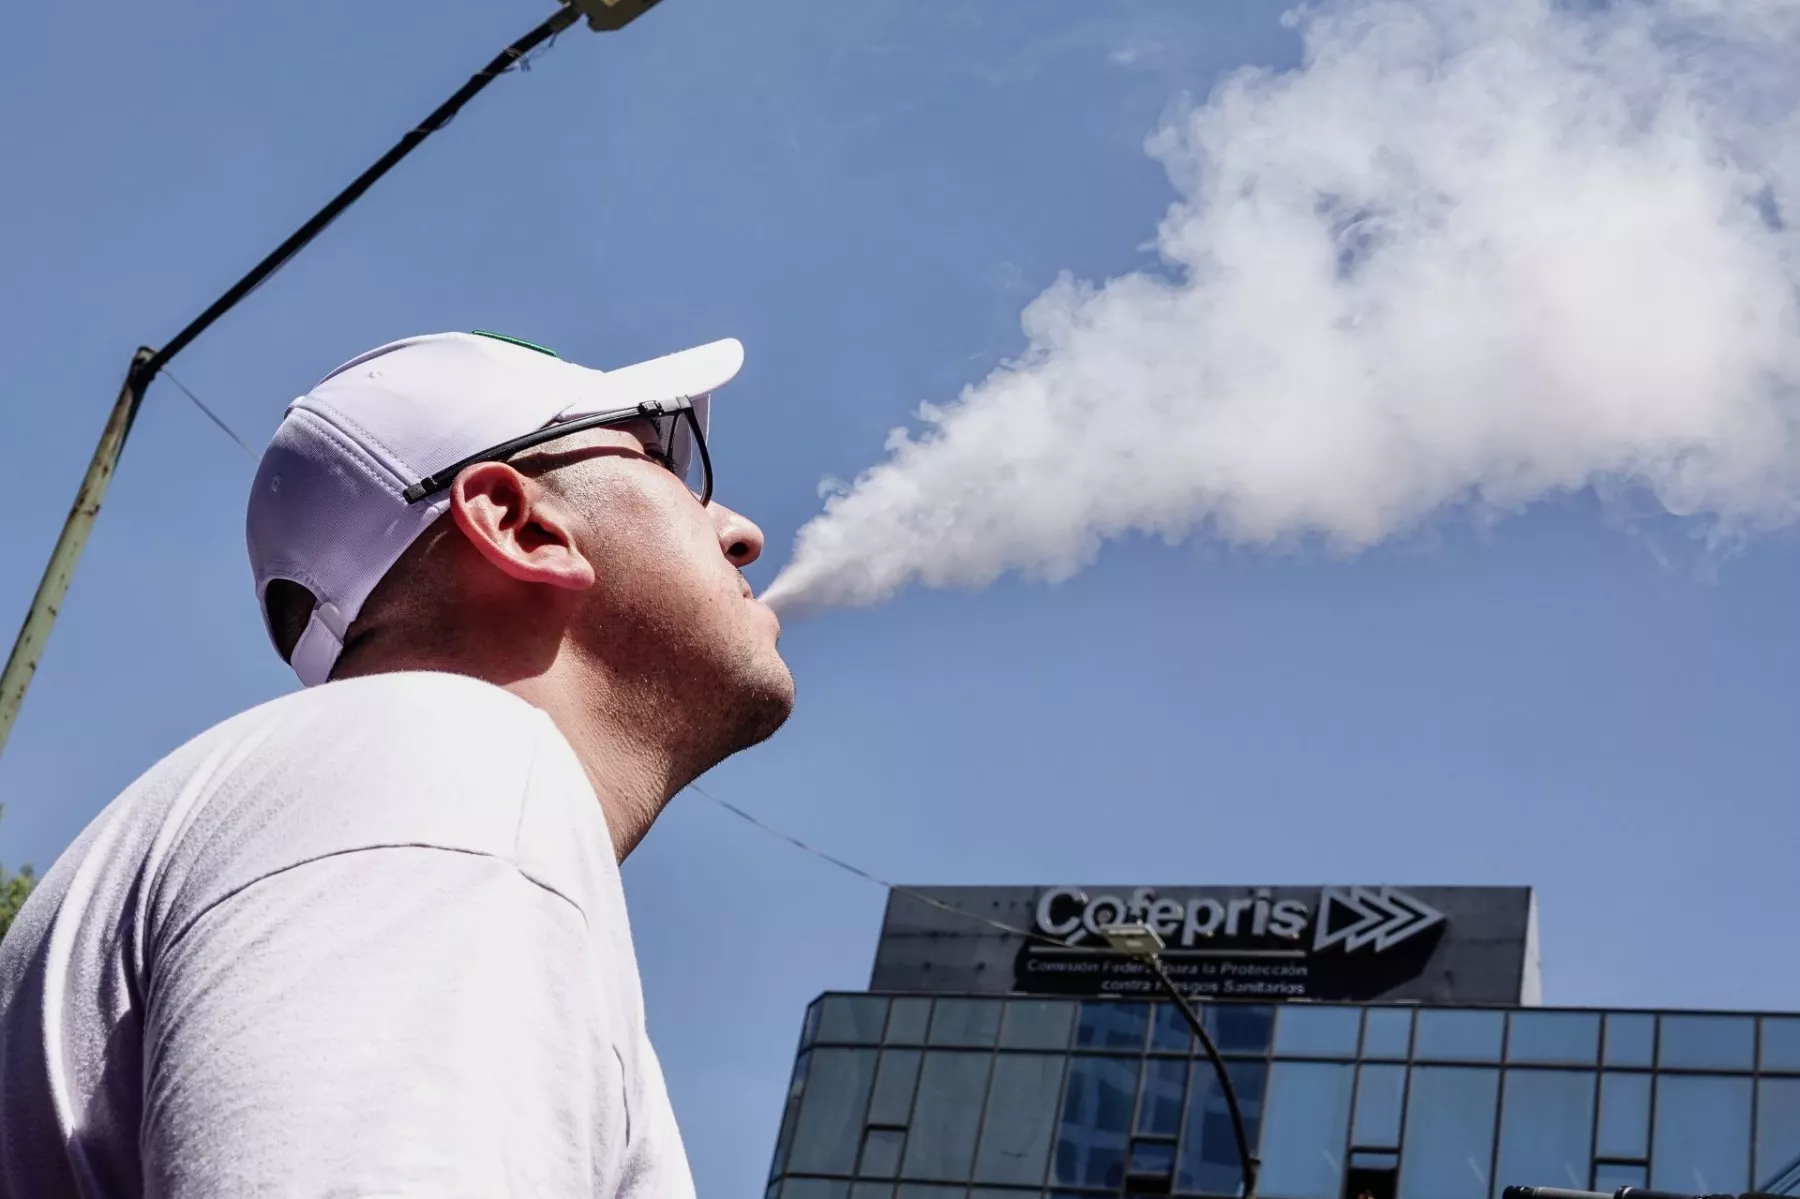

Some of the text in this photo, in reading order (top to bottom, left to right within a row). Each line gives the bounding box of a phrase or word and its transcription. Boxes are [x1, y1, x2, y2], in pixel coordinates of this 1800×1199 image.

[1036, 886, 1309, 947] Cofepris
[1201, 963, 1217, 976] la
[1219, 961, 1308, 977] Protección
[1100, 979, 1151, 991] contra
[1223, 980, 1306, 994] Sanitarios
